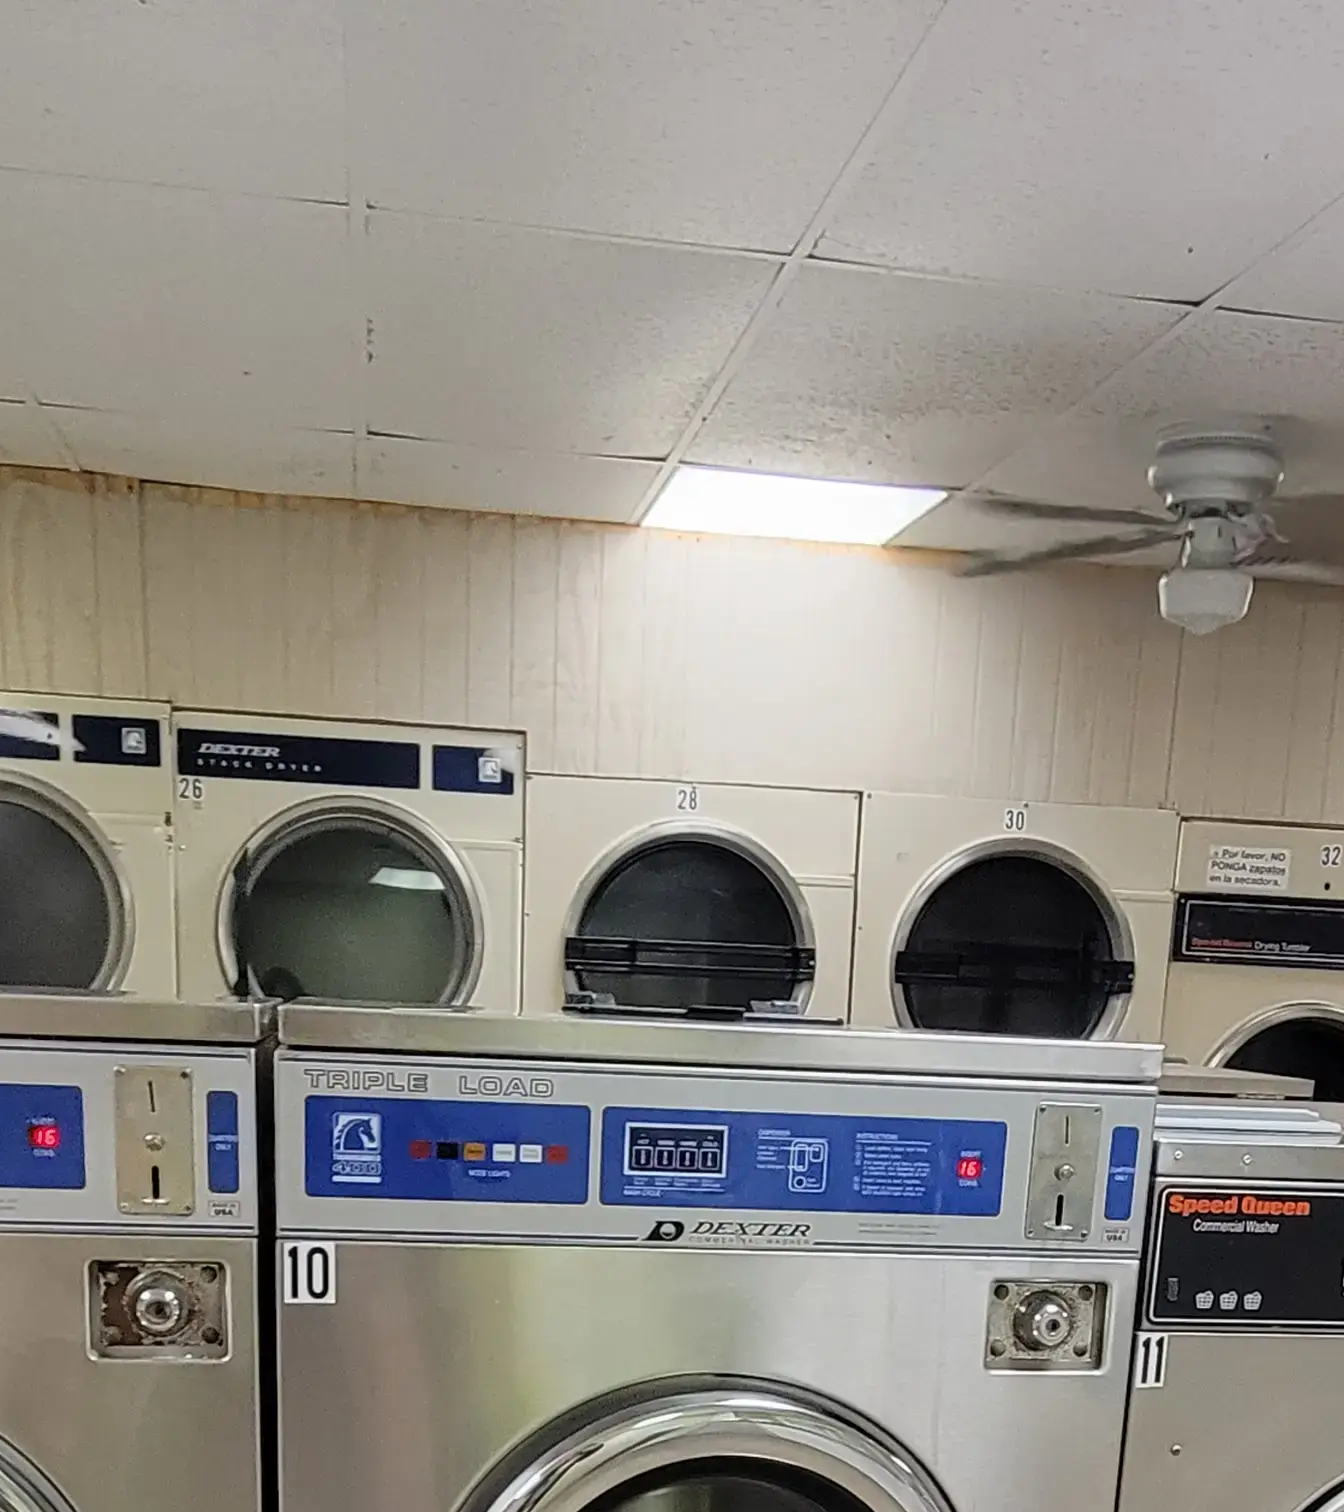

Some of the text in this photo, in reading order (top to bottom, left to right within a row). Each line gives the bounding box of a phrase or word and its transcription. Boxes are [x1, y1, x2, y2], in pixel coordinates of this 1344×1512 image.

[198, 743, 281, 757] DEXTER
[179, 778, 203, 799] 26
[677, 789, 697, 811] 28
[1005, 809, 1025, 831] 30
[1270, 852, 1286, 862] NO
[1321, 846, 1342, 866] 32
[1211, 862, 1248, 872] PONGA
[1223, 874, 1232, 883] la
[304, 1069, 555, 1098] TRIPLE LOAD
[32, 1129, 57, 1145] 16
[959, 1160, 977, 1177] 16
[1169, 1195, 1311, 1216] Speed Queen
[689, 1221, 811, 1237] DEXTER
[1193, 1218, 1280, 1234] Commercial Washer
[288, 1245, 329, 1299] 10
[1141, 1336, 1165, 1384] 11
